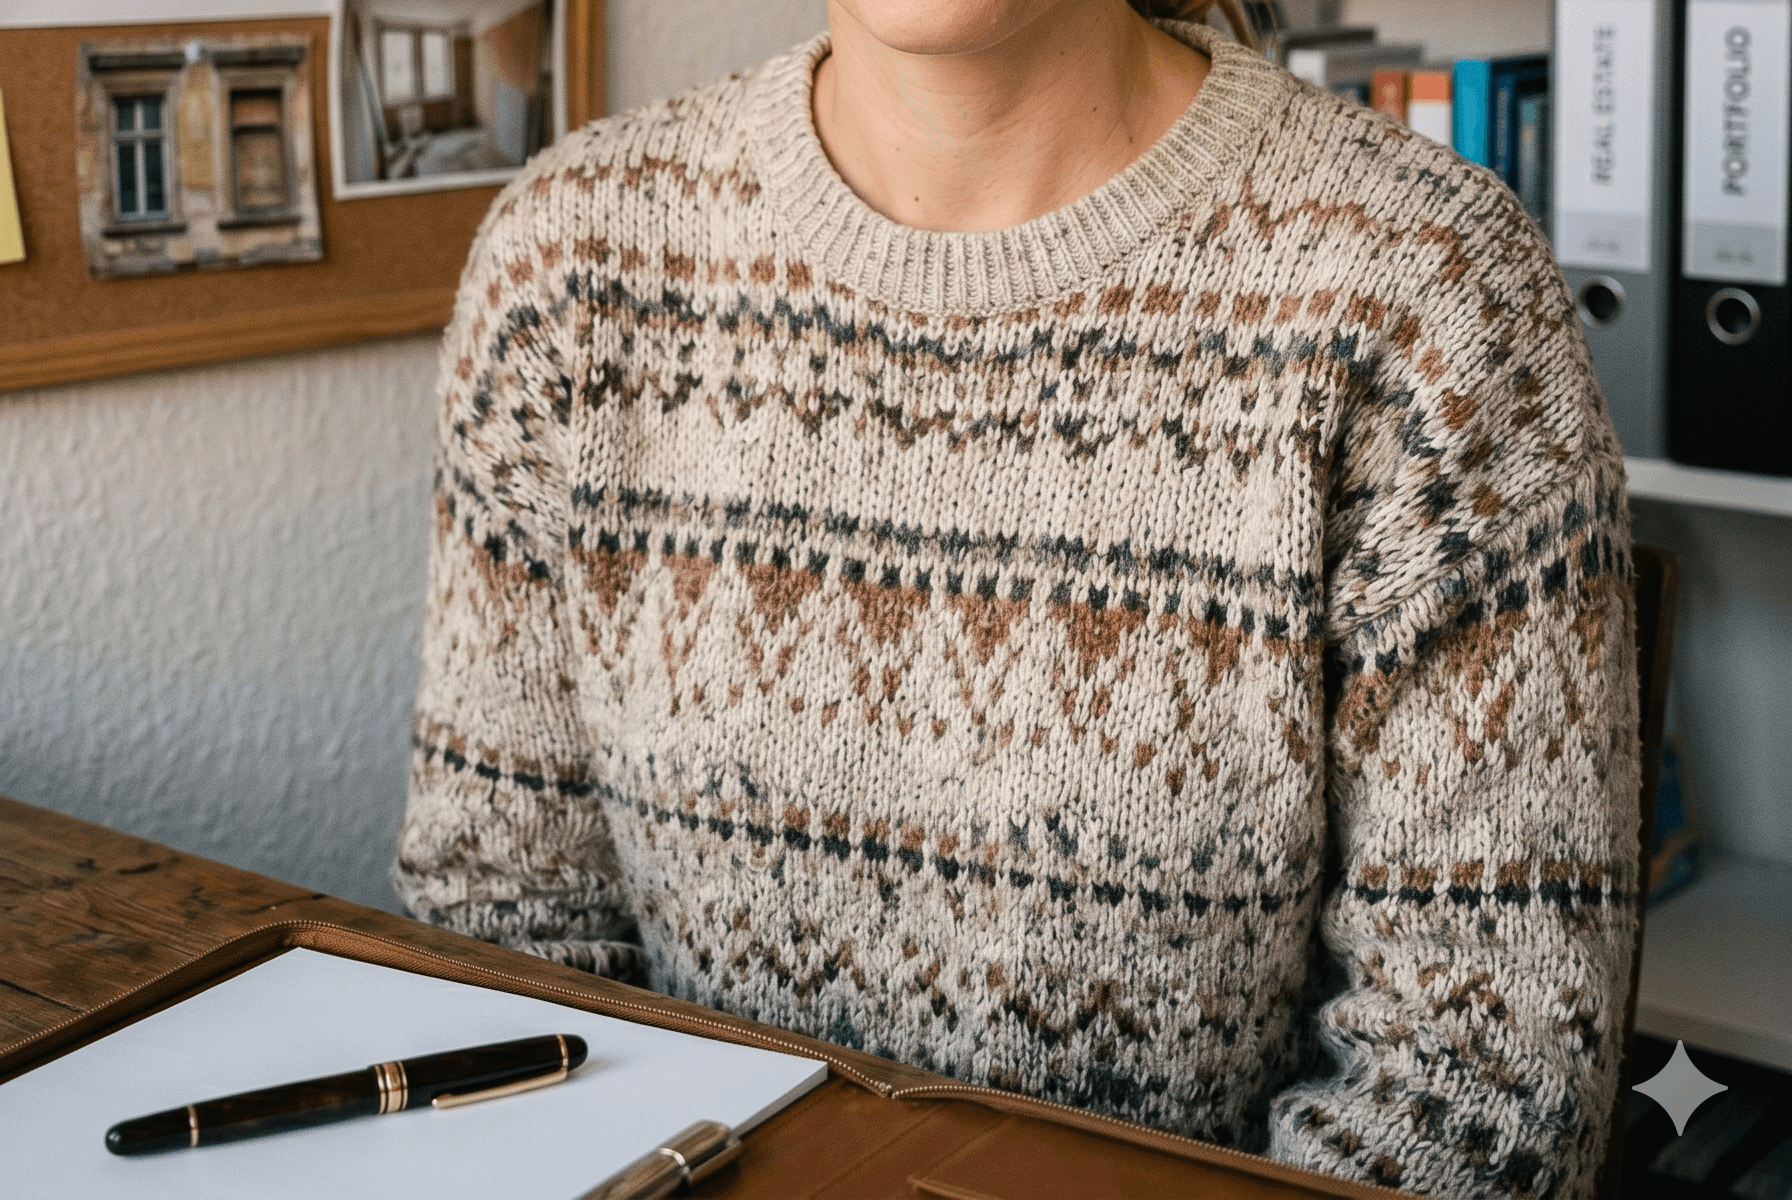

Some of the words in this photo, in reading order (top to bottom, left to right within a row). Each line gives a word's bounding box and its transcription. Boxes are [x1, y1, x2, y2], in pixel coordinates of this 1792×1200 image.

[1591, 24, 1618, 117] ESTATE
[1720, 25, 1753, 197] PORTFOLIO
[1590, 125, 1617, 186] REAL
